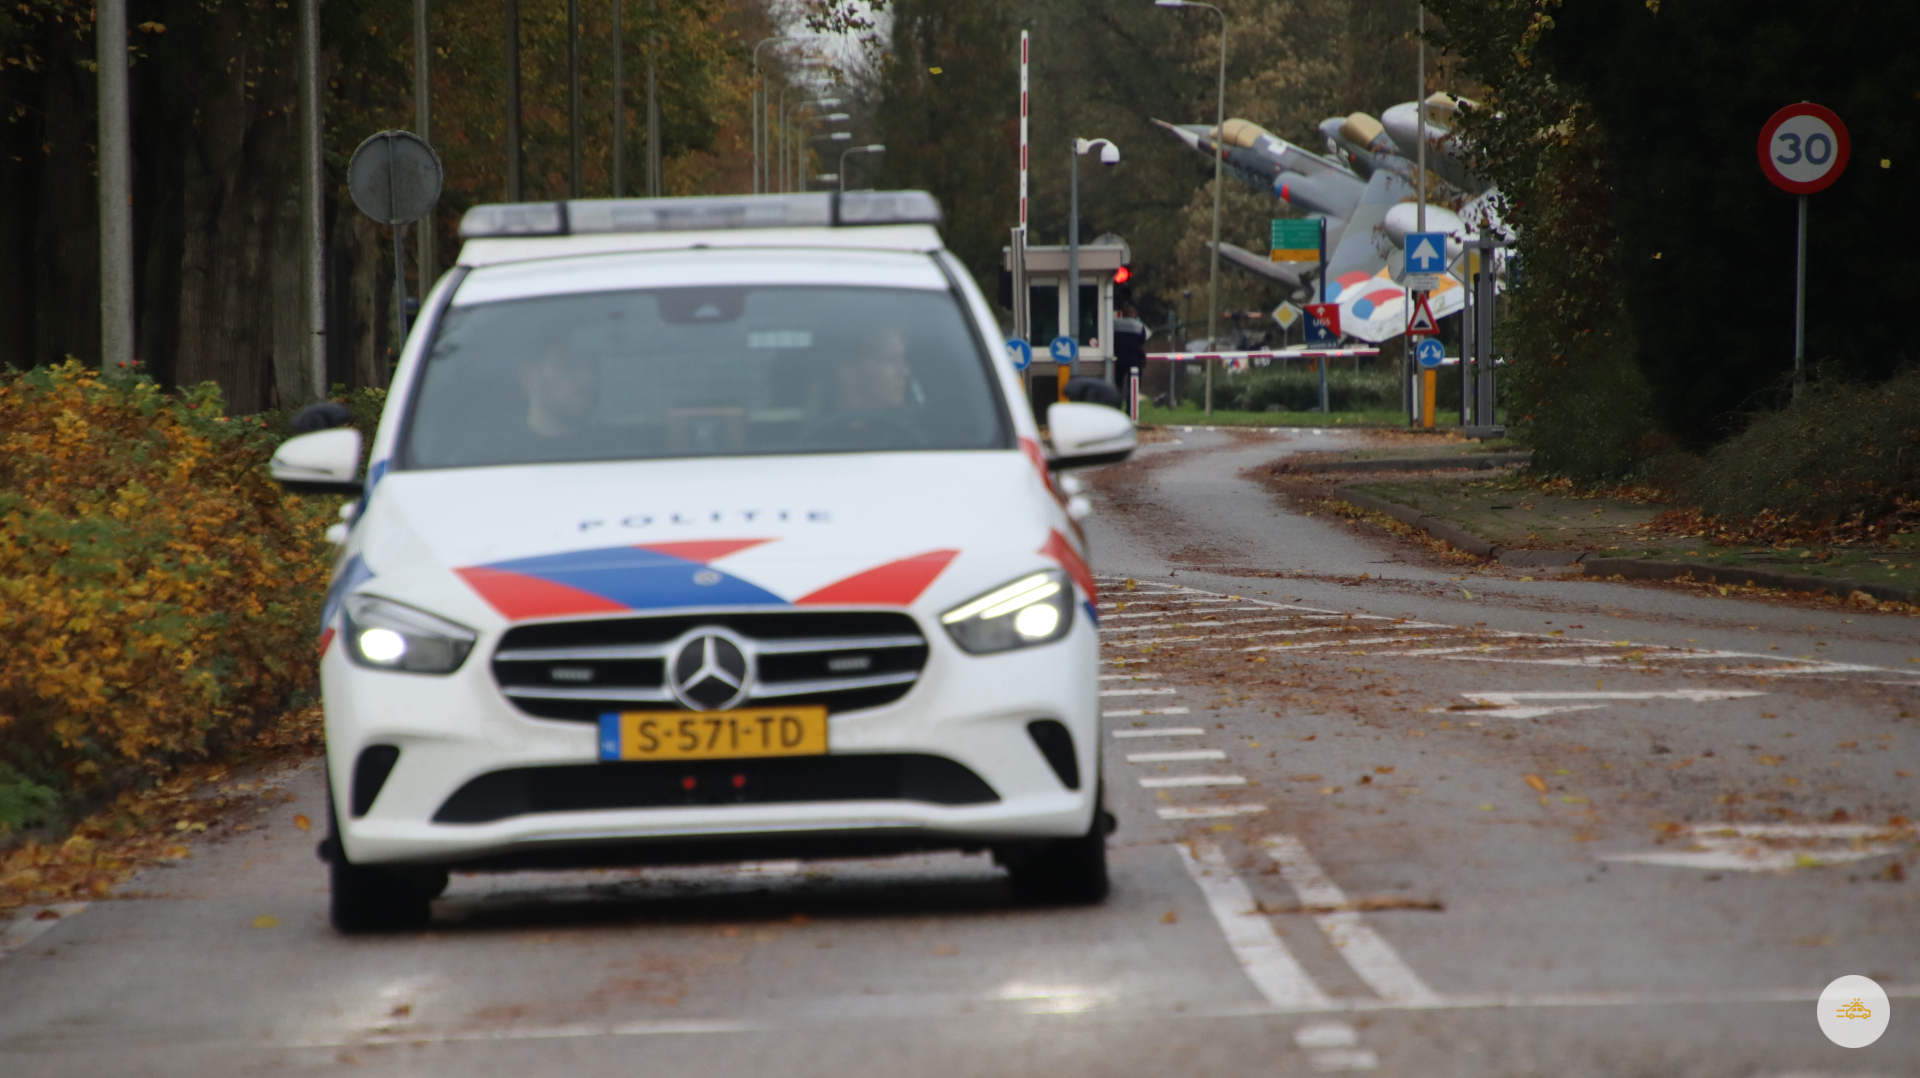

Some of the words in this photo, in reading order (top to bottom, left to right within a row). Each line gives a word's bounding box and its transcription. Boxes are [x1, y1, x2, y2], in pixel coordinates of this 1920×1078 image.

[1776, 132, 1832, 165] 30
[577, 508, 832, 531] POLITIE
[637, 716, 805, 753] S-571-TD
